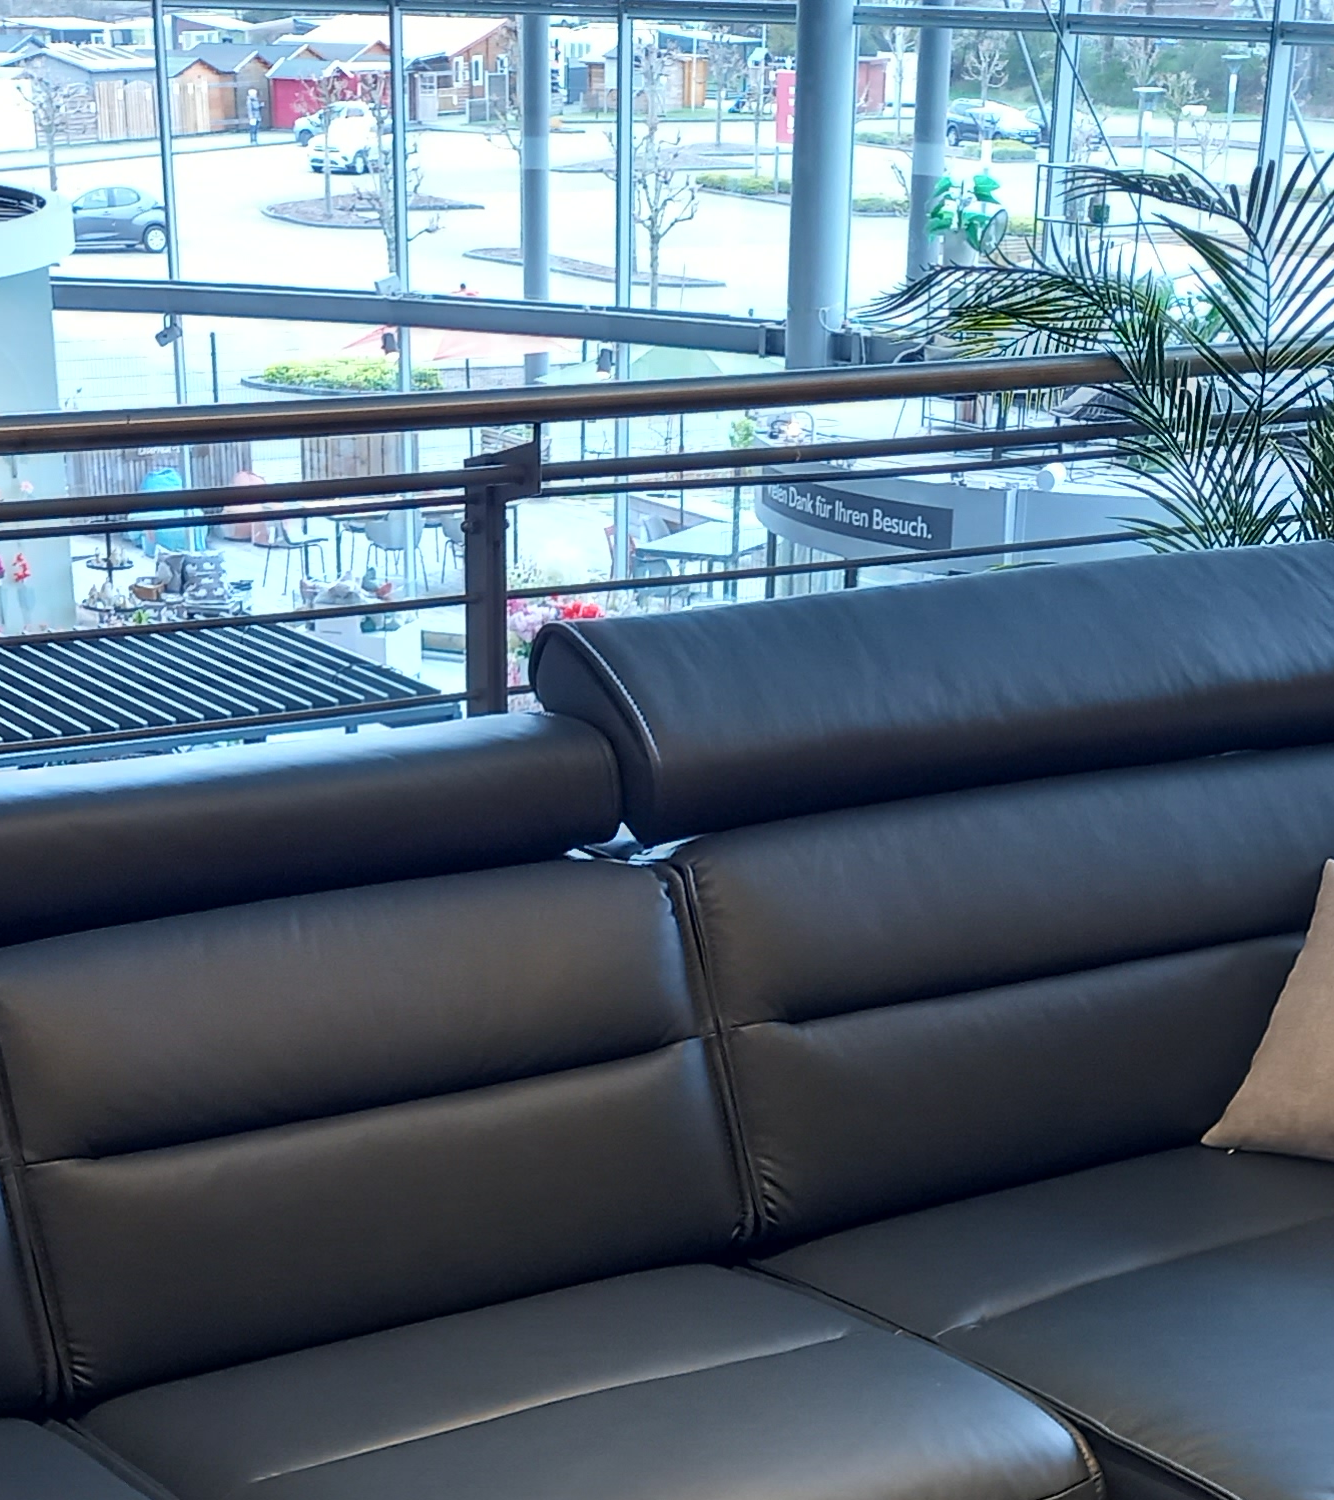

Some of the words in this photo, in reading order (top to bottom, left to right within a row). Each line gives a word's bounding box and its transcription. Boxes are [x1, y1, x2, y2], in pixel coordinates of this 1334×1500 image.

[788, 486, 814, 514] Dank
[815, 495, 833, 519] für
[835, 499, 869, 528] Ihren
[872, 508, 933, 539] Besuch.
